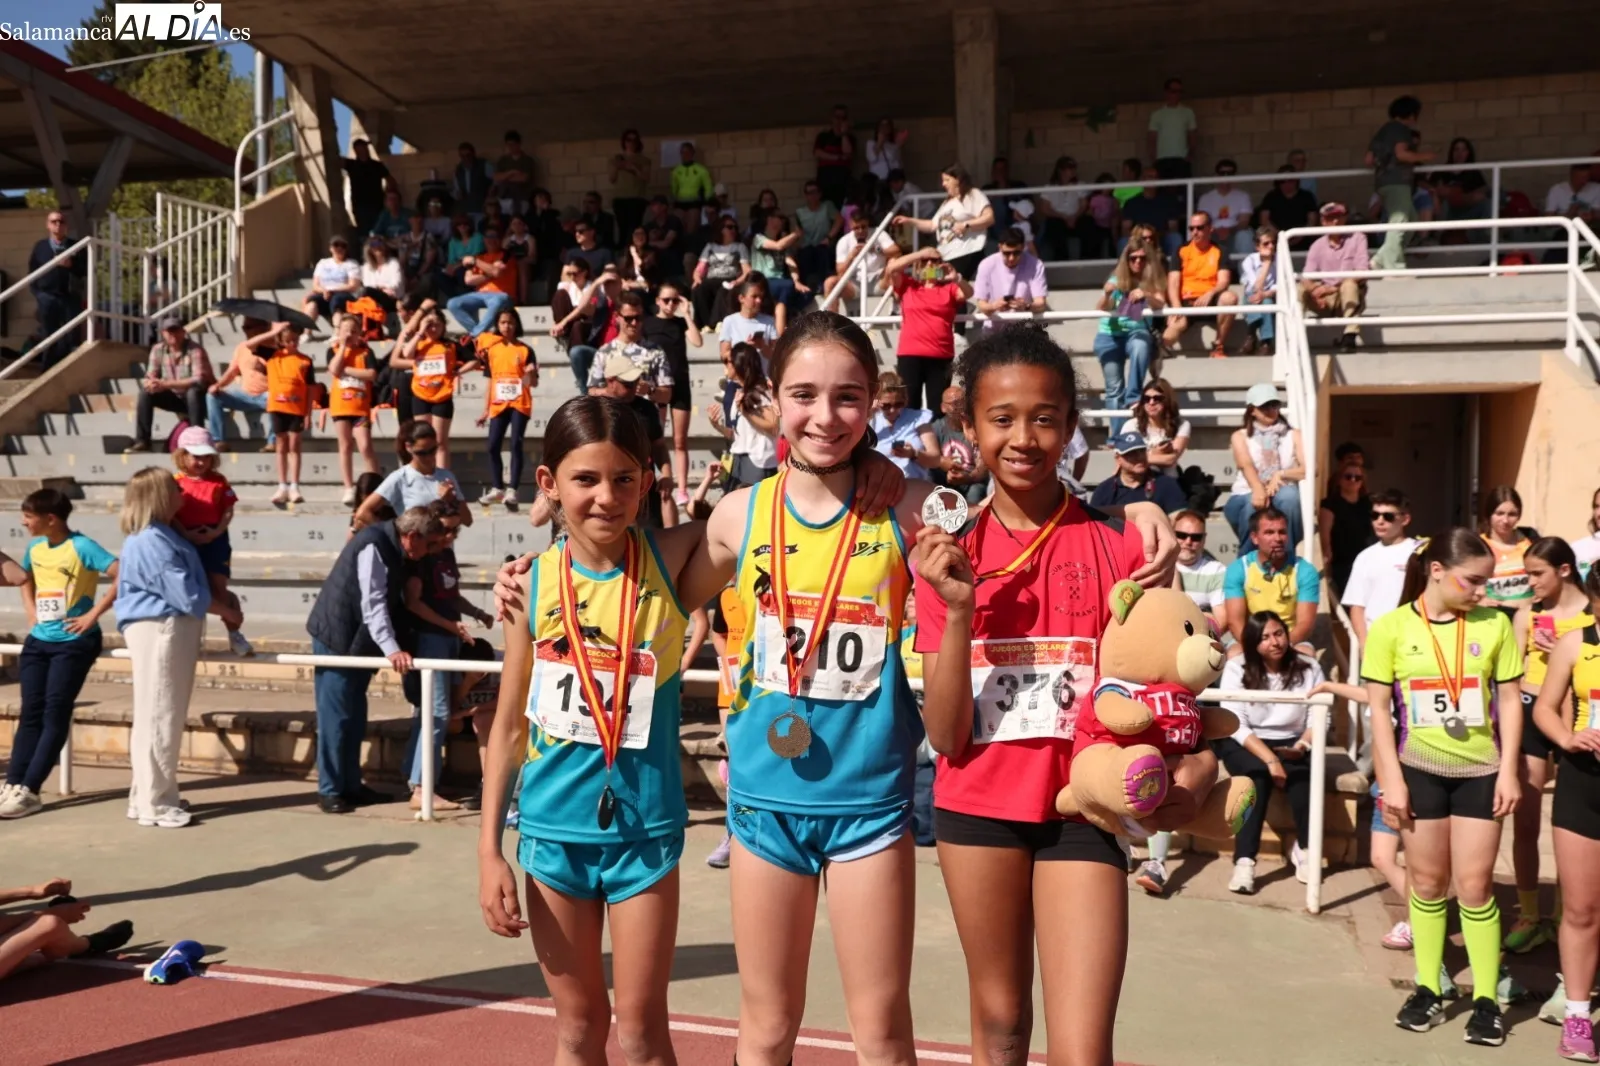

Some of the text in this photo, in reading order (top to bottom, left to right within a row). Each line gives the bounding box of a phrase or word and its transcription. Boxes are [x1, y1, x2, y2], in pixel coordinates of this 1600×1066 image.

[423, 361, 442, 371] 255
[500, 385, 517, 396] 258
[507, 532, 525, 543] 19
[780, 625, 863, 673] 210
[1023, 643, 1071, 652] ESCOLARES
[586, 649, 616, 659] ESCOLA
[996, 670, 1076, 713] 376
